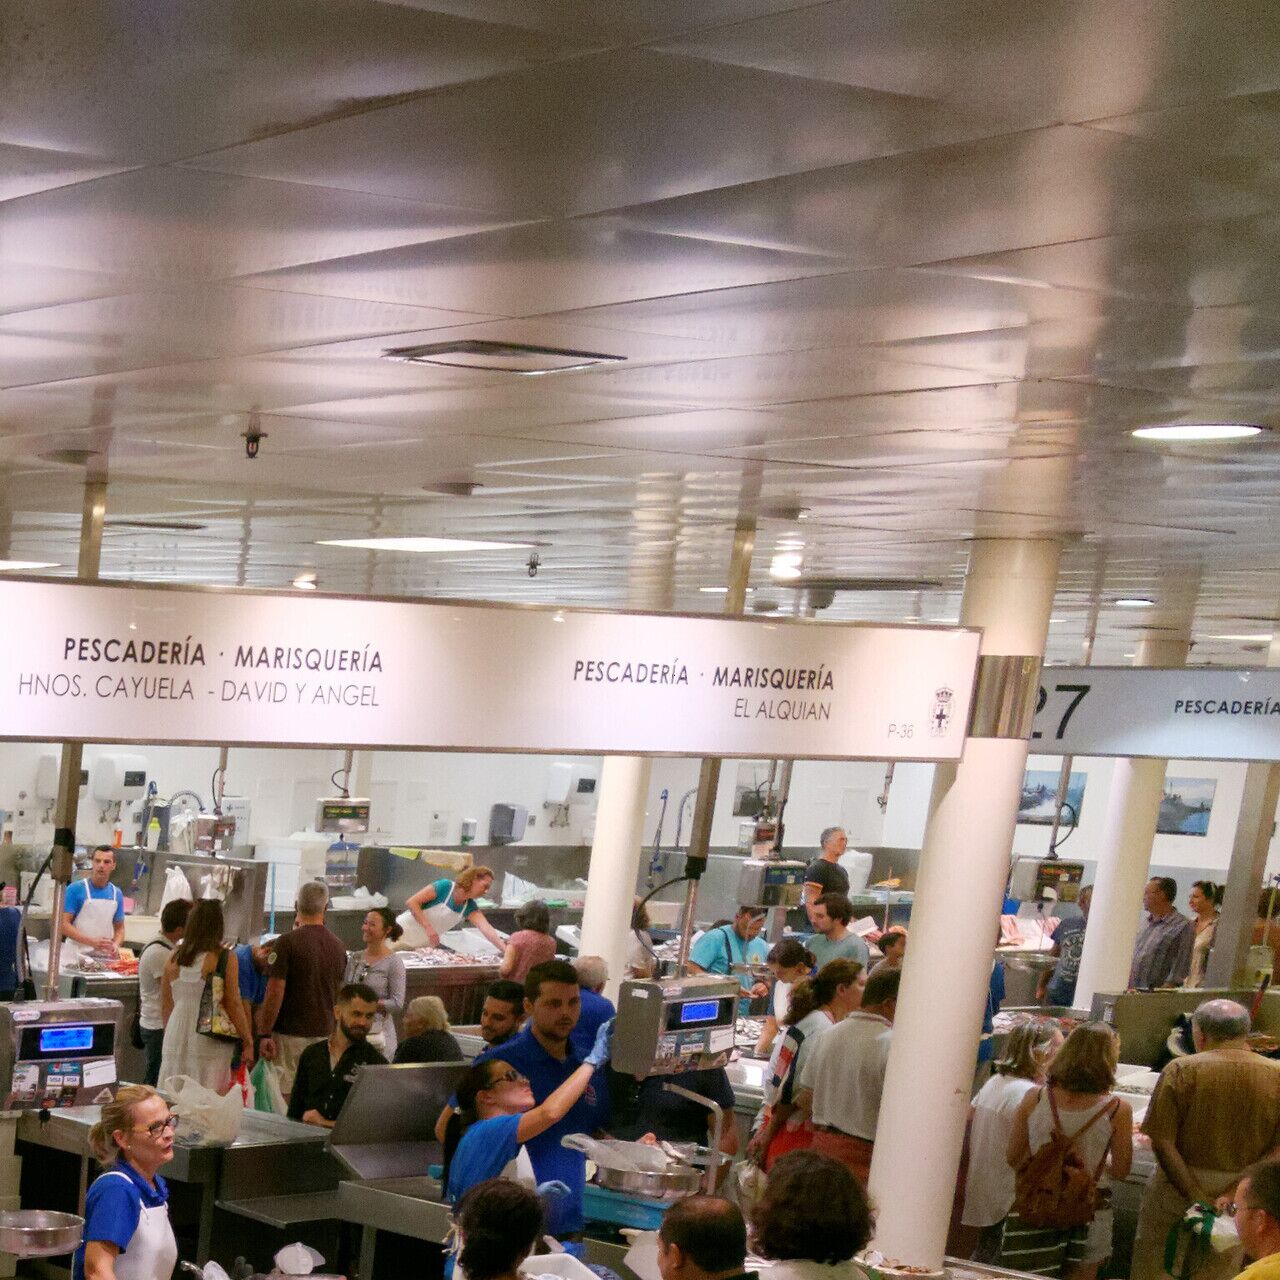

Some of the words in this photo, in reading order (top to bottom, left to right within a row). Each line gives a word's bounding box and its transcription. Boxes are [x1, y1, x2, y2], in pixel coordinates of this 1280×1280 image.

[63, 636, 206, 666] PESCADERÍA
[234, 643, 383, 673] MARISQUERÍA
[572, 657, 689, 686] PESCADERÍA
[711, 663, 835, 692] MARISQUERÍA
[18, 673, 88, 698] HNOS.
[95, 674, 194, 701] CAYUELA
[220, 680, 288, 703] DAVID
[296, 682, 307, 704] Y
[311, 684, 380, 707] ANGEL
[733, 697, 752, 720] EL
[755, 698, 832, 723] ALQUIAN
[1173, 696, 1280, 716] PESCADERÍA
[888, 723, 914, 739] P-36
